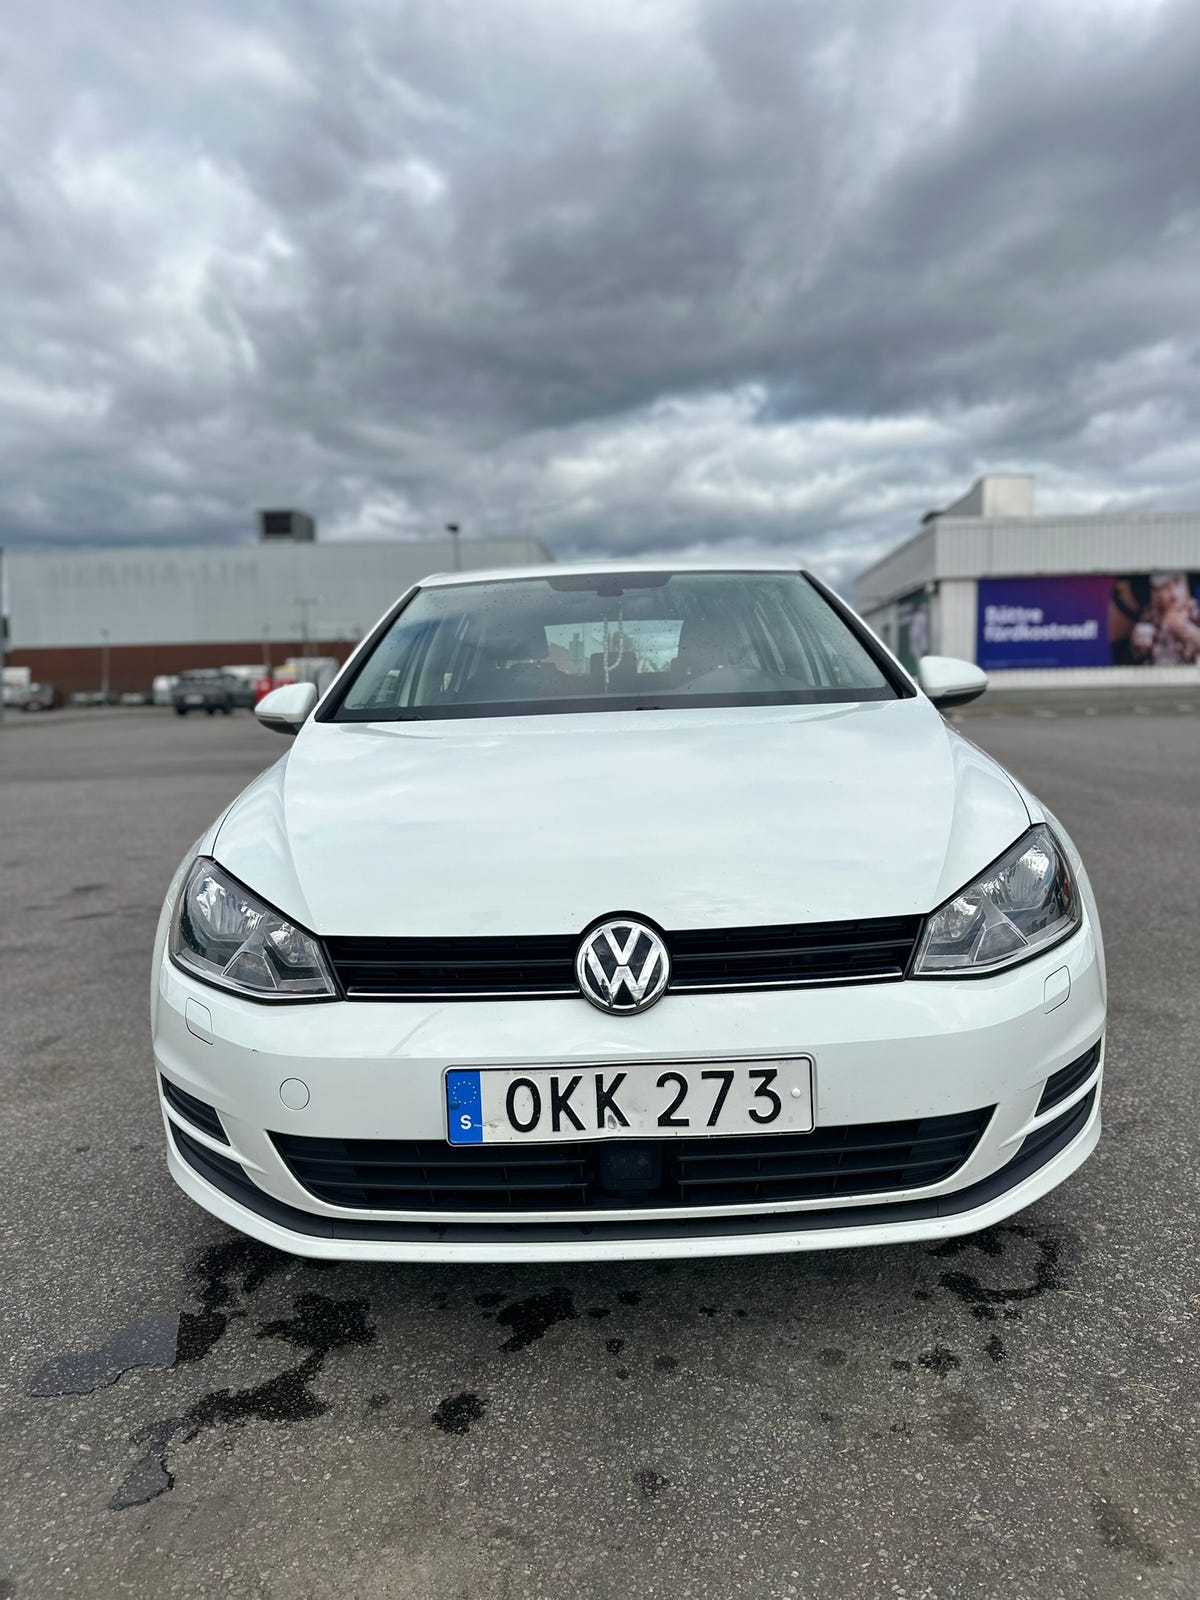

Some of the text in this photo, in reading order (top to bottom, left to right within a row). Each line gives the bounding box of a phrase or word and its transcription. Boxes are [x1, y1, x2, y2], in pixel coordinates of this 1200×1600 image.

[505, 1068, 782, 1133] OKK 273
[460, 1114, 472, 1130] S
